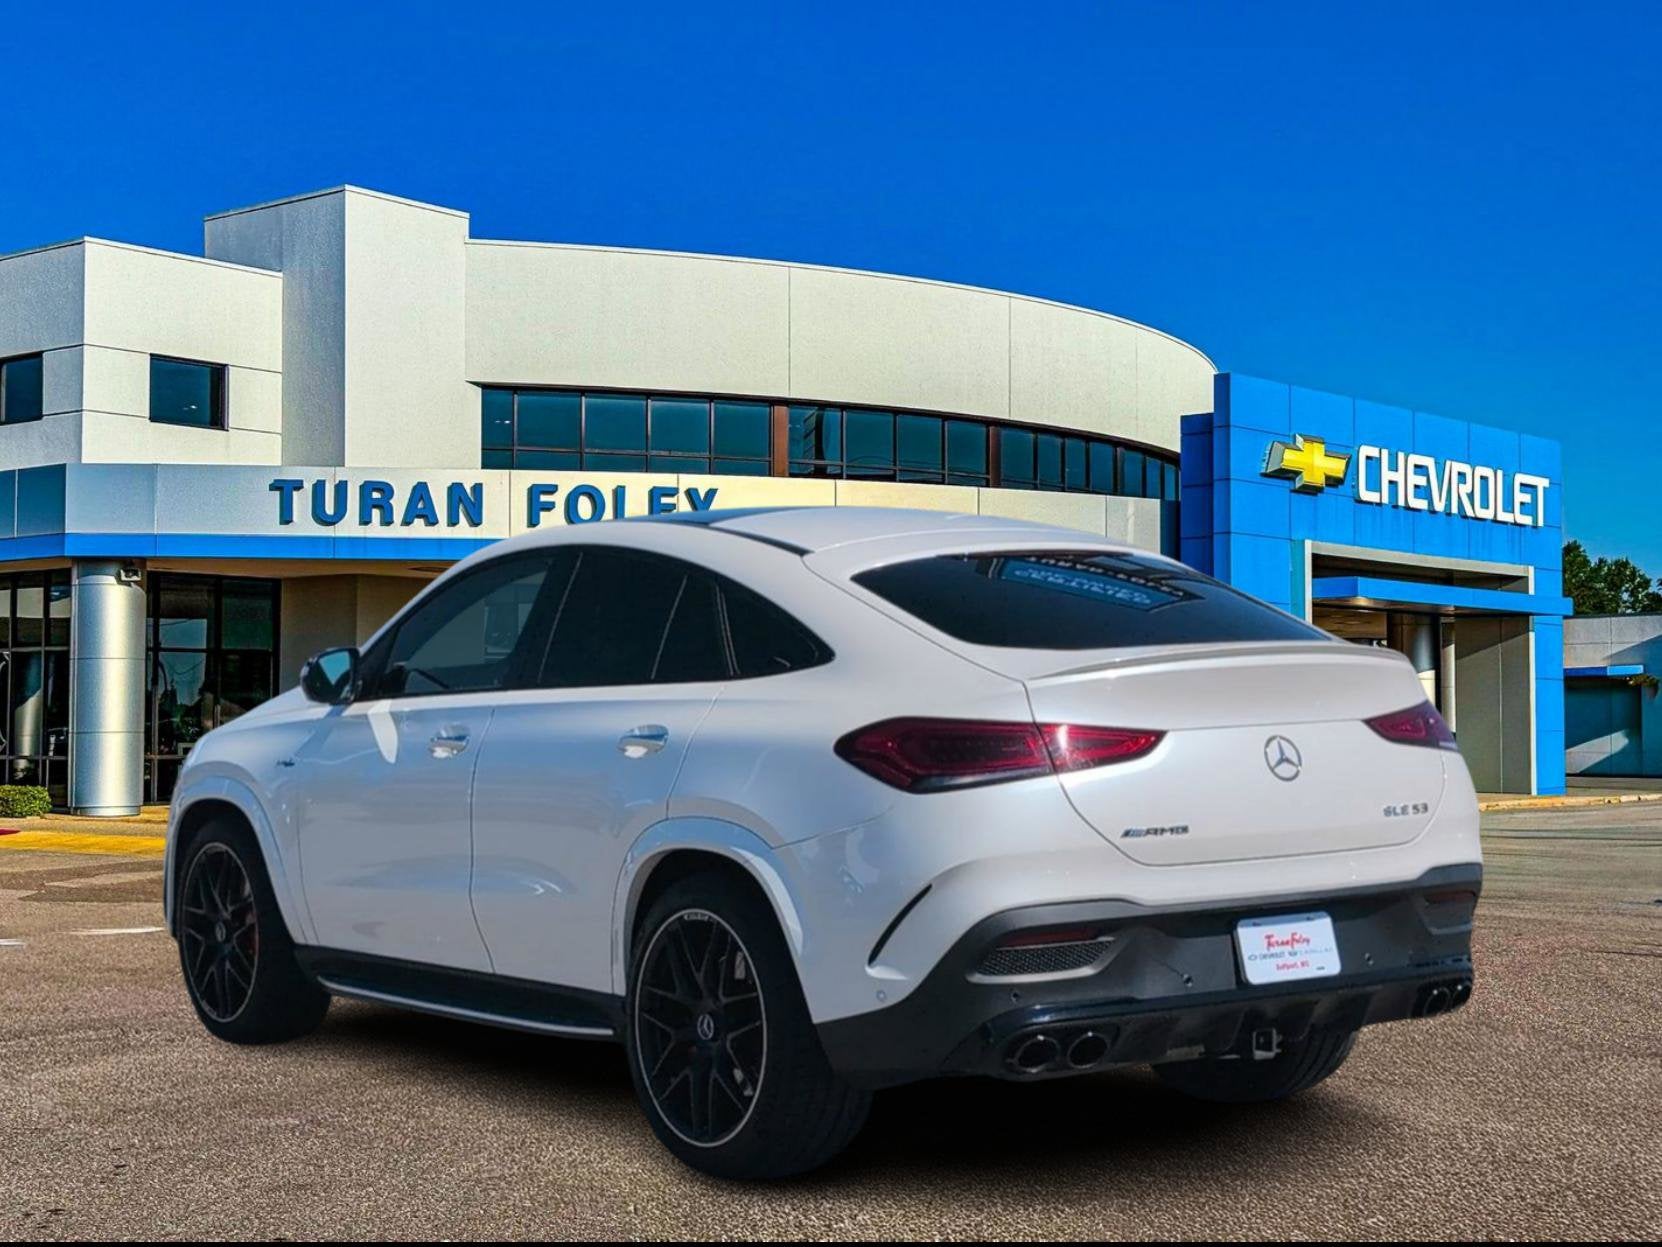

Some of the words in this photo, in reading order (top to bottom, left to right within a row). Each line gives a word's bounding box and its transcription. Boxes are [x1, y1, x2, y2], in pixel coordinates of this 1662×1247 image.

[268, 478, 484, 527] TURAN
[1357, 444, 1550, 527] CHEVROLET
[1412, 802, 1428, 815] 53
